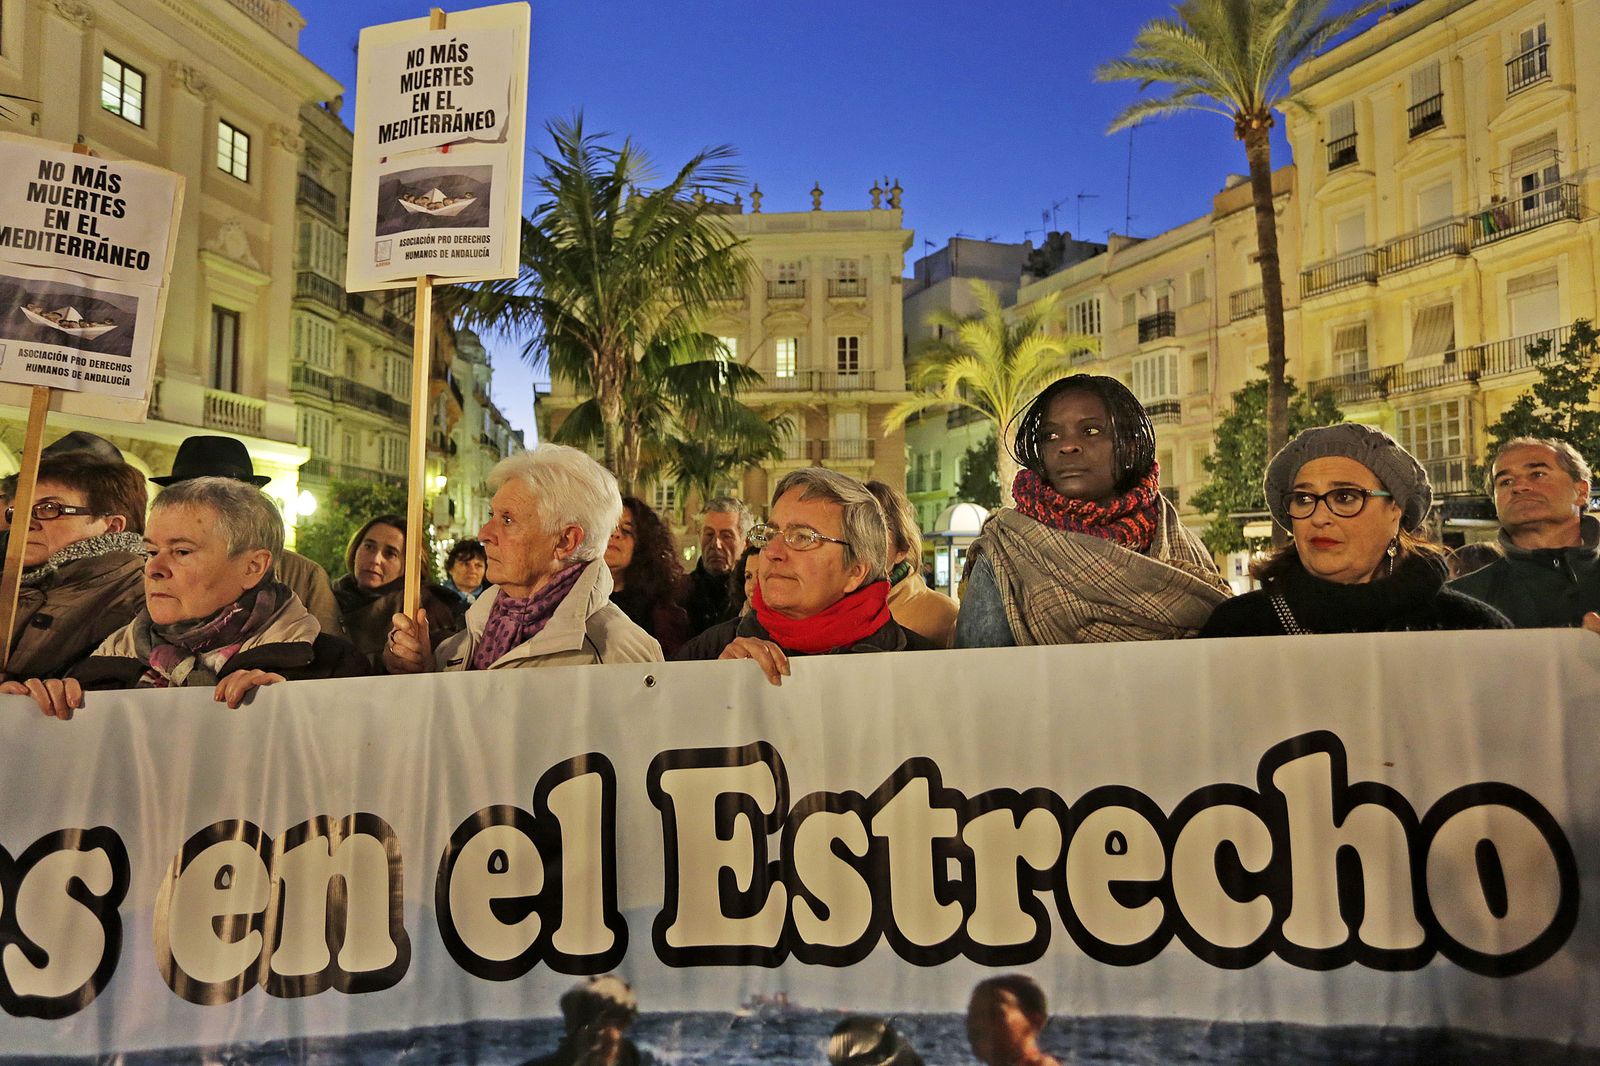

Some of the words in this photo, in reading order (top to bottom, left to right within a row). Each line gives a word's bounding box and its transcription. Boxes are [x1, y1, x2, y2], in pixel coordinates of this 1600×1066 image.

[406, 48, 425, 69] NO
[430, 38, 468, 64] MÁS
[401, 66, 474, 94] MUERTES
[412, 91, 431, 113] EN
[436, 90, 456, 111] EL
[378, 108, 495, 144] MEDITERRÁNEO
[38, 159, 66, 182] NO
[72, 165, 122, 193] MÁS
[26, 181, 127, 219] MUERTES
[44, 208, 70, 231] EN
[77, 213, 101, 238] EL
[399, 234, 435, 247] ASOCIACIÓN
[437, 235, 452, 245] PRO
[453, 234, 491, 245] DERECHOS
[405, 250, 438, 260] HUMANOS
[439, 249, 450, 259] DE
[451, 247, 490, 259] ANDALUCÍA
[18, 348, 69, 363] ASOCIACIÓN
[70, 355, 87, 368] PRO
[89, 359, 132, 373] DERECHOS
[25, 363, 69, 377] HUMANOS
[71, 370, 83, 380] DE
[84, 371, 131, 386] ANDALUCÍA
[0, 826, 130, 1020] s
[153, 812, 412, 1006] en
[435, 752, 628, 982] el
[646, 730, 1579, 977] Estrecho
